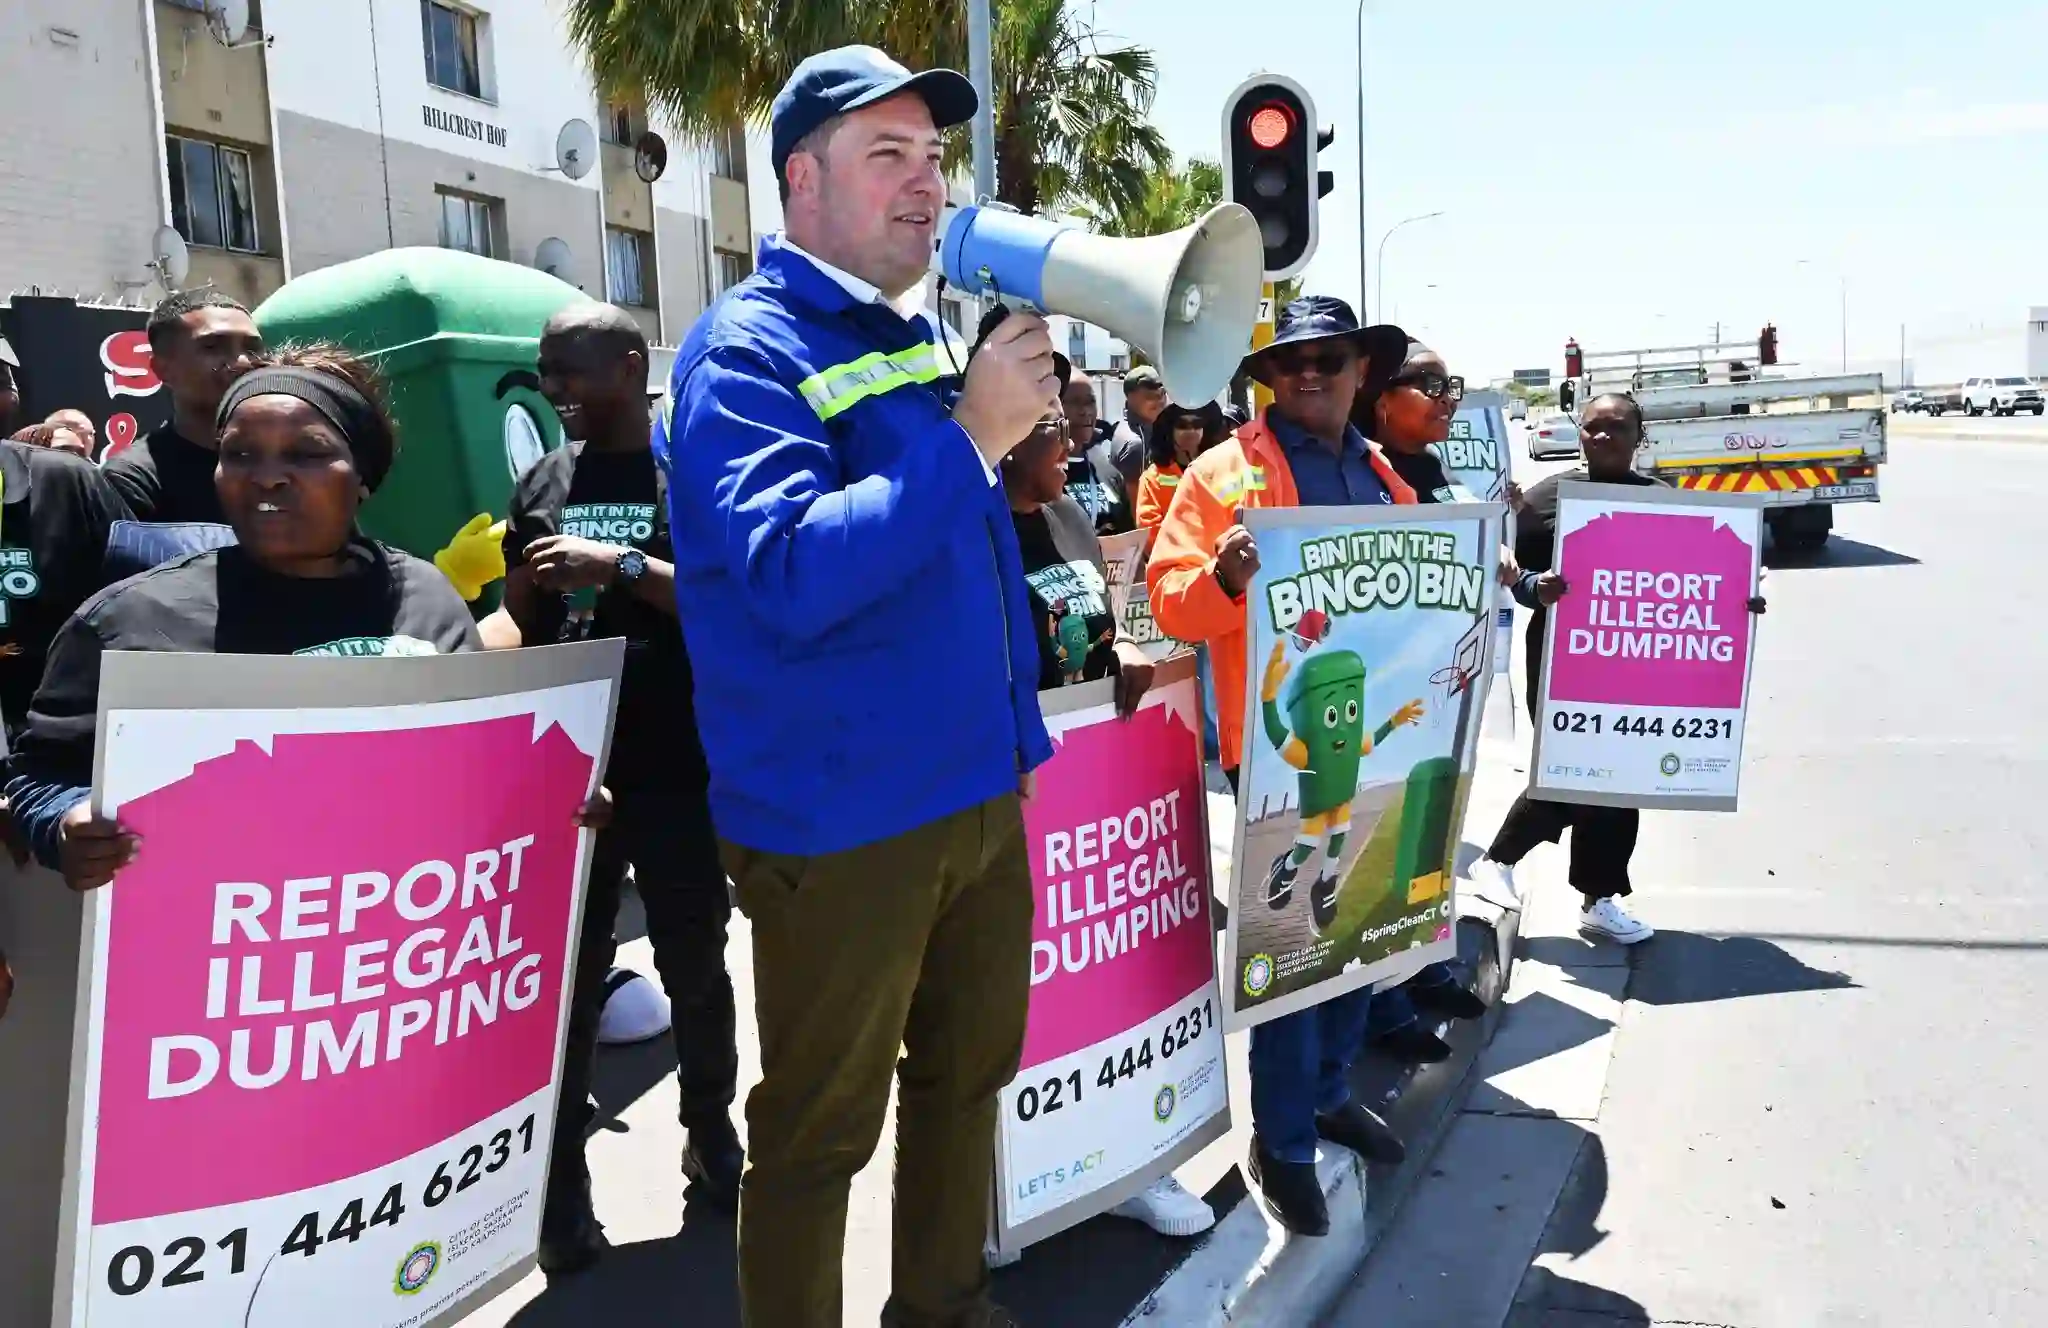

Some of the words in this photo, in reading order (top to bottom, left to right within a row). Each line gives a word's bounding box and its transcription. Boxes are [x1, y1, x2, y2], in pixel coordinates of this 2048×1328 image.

[422, 104, 484, 141] HILLCREST
[1447, 421, 1470, 438] HE
[1446, 440, 1497, 469] BIN
[562, 520, 653, 540] BINGO
[564, 507, 590, 520] BIN
[592, 505, 608, 517] IT
[608, 505, 624, 517] IN
[626, 505, 656, 518] THE
[0, 551, 30, 567] HE
[1303, 537, 1348, 571] BIN
[1351, 532, 1376, 562] IT
[1378, 532, 1404, 560] IN
[1408, 534, 1455, 562] THE
[1268, 561, 1410, 630] BINGO
[1417, 562, 1484, 610] BIN
[1591, 568, 1723, 601] REPORT
[1588, 600, 1721, 631] ILLEGAL
[1568, 629, 1734, 662] DUMPING
[1552, 711, 1602, 734] 021
[1612, 715, 1664, 737] 444
[1671, 718, 1732, 739] 6231
[1587, 767, 1615, 779] ACT
[1045, 788, 1180, 877] REPORT
[211, 833, 535, 945] REPORT
[1046, 839, 1187, 928] ILLEGAL
[1030, 877, 1200, 986] DUMPING
[1361, 907, 1437, 943] #SpringCleanCT
[206, 903, 523, 1019] ILLEGAL
[147, 953, 542, 1100] DUMPING
[1016, 1068, 1082, 1122] 021
[1096, 1037, 1154, 1090] 444
[1161, 998, 1213, 1059] 6231
[1071, 1149, 1106, 1178] ACT
[107, 1227, 248, 1296] 021
[280, 1182, 406, 1258] 444
[422, 1112, 536, 1208] 6231
[449, 1228, 468, 1244] CITY
[469, 1219, 481, 1232] OF
[483, 1203, 504, 1222] CAPE
[507, 1187, 530, 1207] TOWN
[447, 1246, 469, 1264] STAD
